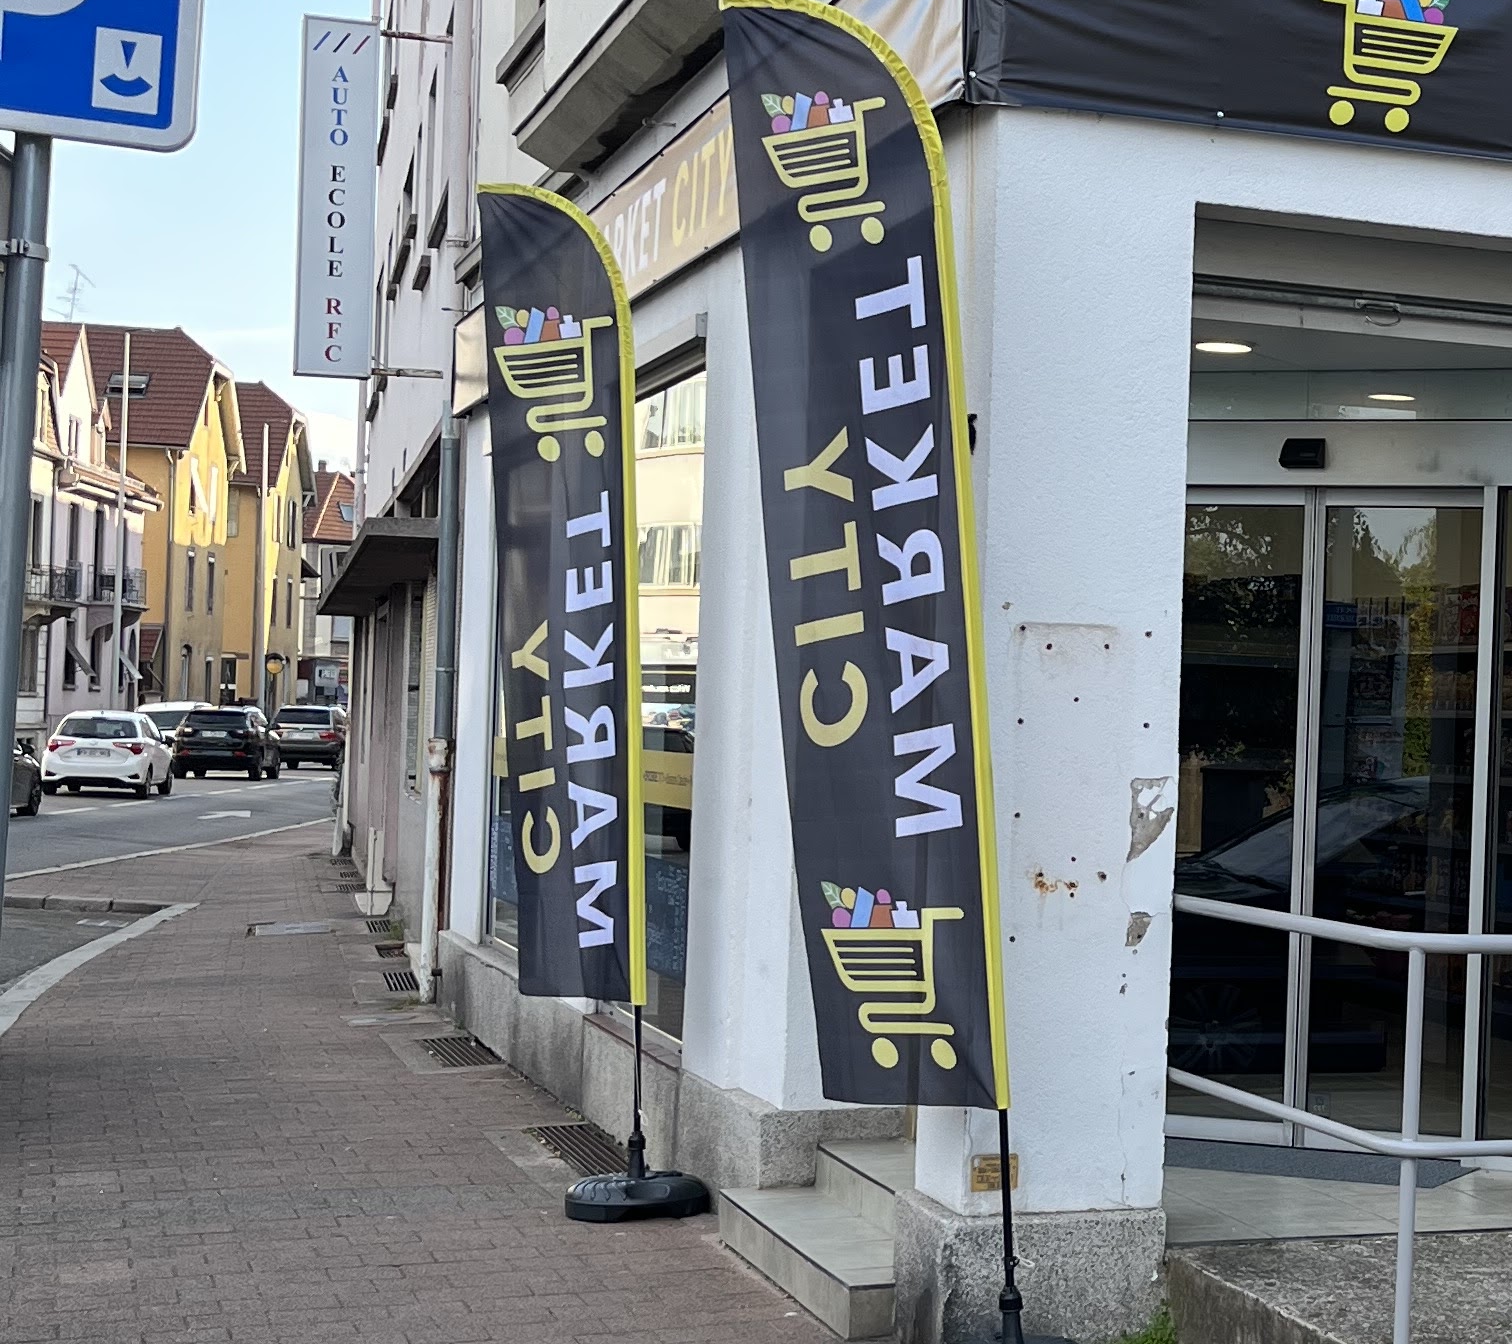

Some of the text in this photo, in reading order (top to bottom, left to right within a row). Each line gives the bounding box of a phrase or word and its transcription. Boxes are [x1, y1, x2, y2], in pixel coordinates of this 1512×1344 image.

[324, 65, 349, 363] AUTO ECOLE RFC
[604, 123, 733, 281] RKET CITY
